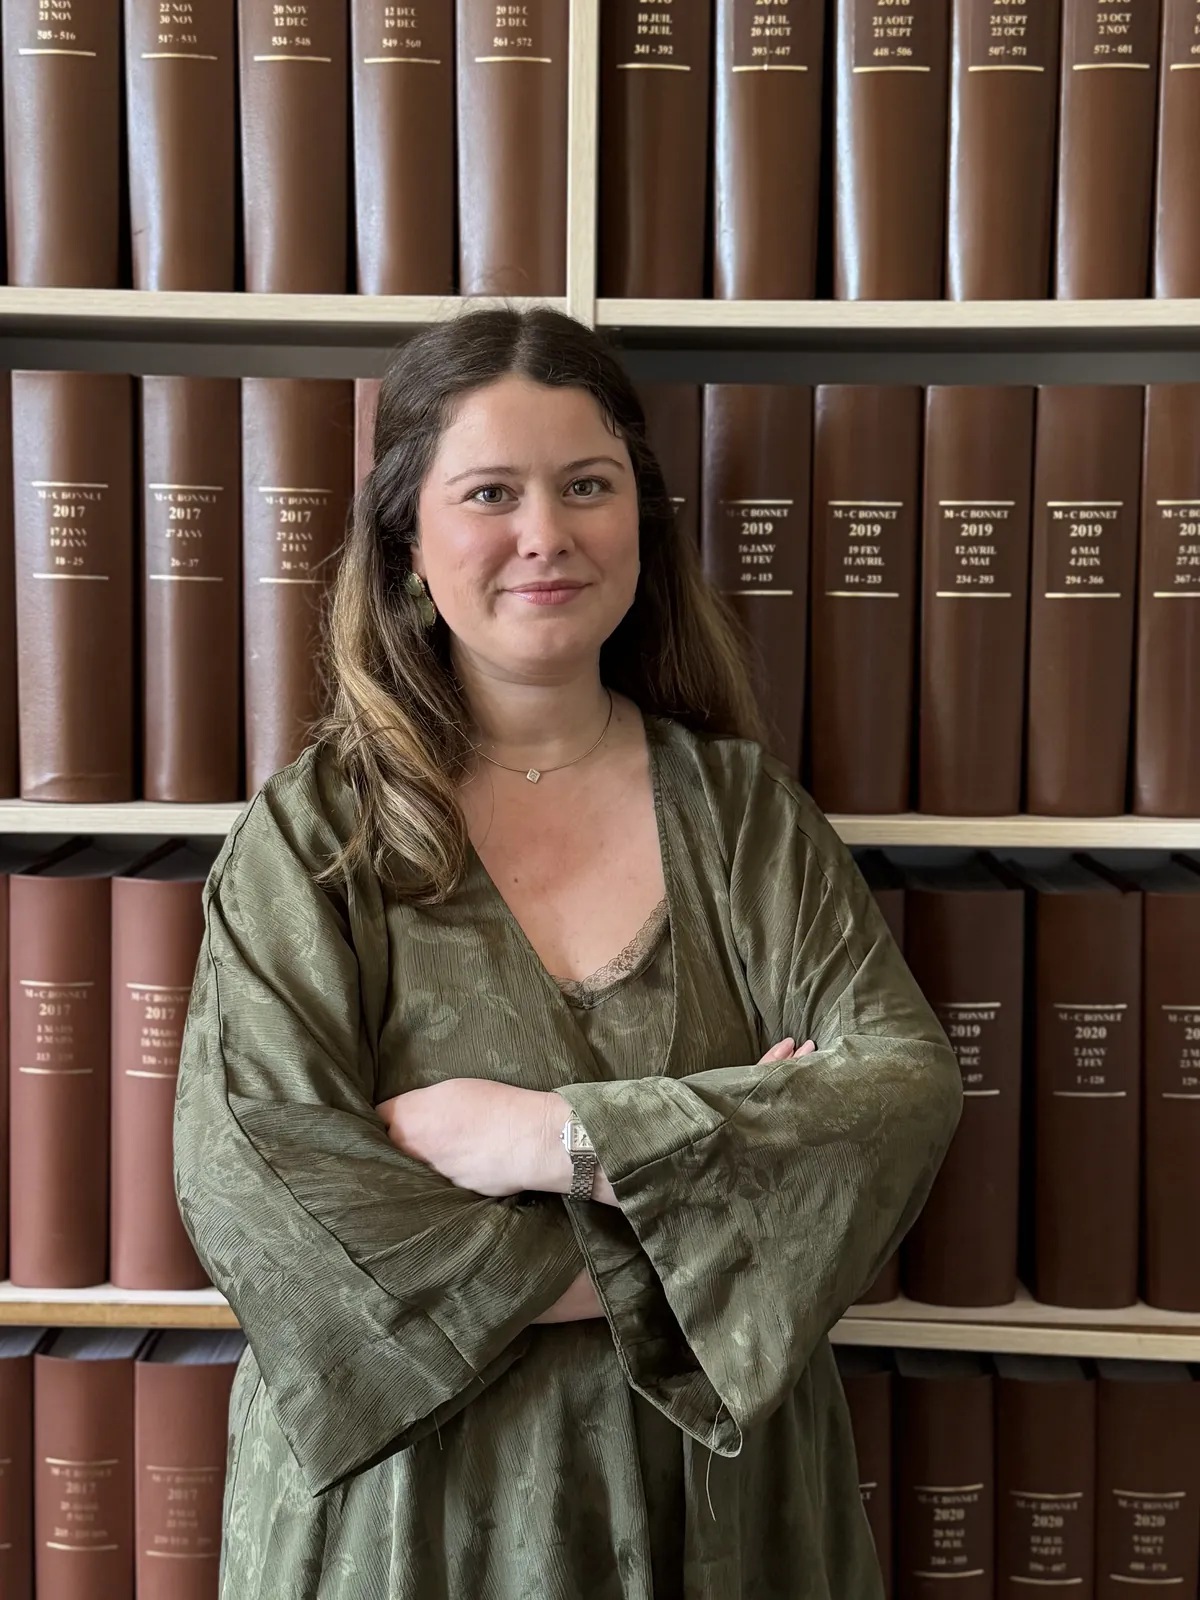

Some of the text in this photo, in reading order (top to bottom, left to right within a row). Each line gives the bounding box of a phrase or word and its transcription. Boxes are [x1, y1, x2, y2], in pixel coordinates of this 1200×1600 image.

[40, 0, 49, 9] 15
[160, 4, 170, 12] 22
[273, 5, 307, 14] 30 NOV
[385, 7, 417, 16] 12 DEC
[496, 6, 506, 15] 20
[39, 11, 48, 20] 21
[160, 15, 170, 24] 30
[638, 13, 672, 23] 10 JUIL
[754, 15, 789, 24] 20 JUIL
[990, 15, 1028, 24] 24 SEPT
[1096, 13, 1132, 22] 23 OCT
[275, 17, 308, 26] 12 DEC
[385, 19, 417, 28] 19 DEC
[496, 18, 506, 27] 23
[872, 16, 914, 25] 21 AOUT
[637, 25, 672, 35] 19 JUIL
[751, 27, 791, 36] 20 AOUT
[874, 28, 912, 37] 21 SEPT
[991, 27, 1026, 36] 22 OCT
[1098, 25, 1130, 34] 2 NOV
[60, 31, 76, 40] 516
[158, 34, 173, 43] 517
[382, 38, 397, 48] 549
[516, 38, 532, 46] 572
[634, 44, 673, 54] 341 392
[752, 46, 790, 56] 393 447
[873, 47, 912, 56] 448 506
[1012, 46, 1026, 56] 571
[1094, 44, 1132, 54] 572 601
[53, 504, 85, 518] 2017
[169, 507, 201, 520] 2017
[750, 509, 789, 517] BONNET
[858, 510, 897, 519] BONNET
[970, 510, 1008, 518] BONNET
[1080, 510, 1117, 519] BONNET
[1189, 509, 1200, 518] BO
[280, 510, 311, 523] 2017
[742, 522, 773, 535] 2019
[849, 523, 881, 536] 2019
[960, 523, 993, 536] 2019
[1070, 524, 1102, 537] 2019
[1179, 523, 1200, 536] 201
[276, 532, 286, 540] 27
[738, 544, 776, 553] 16 JANV
[849, 546, 880, 554] 19 FEV
[955, 546, 996, 554] 12 AVRIL
[1071, 546, 1100, 555] 6 MAI
[1187, 545, 1200, 554] JU
[742, 555, 772, 564] 18 FEV
[844, 557, 885, 566] 11 AVRIL
[961, 557, 990, 566] 6 MAI
[1069, 557, 1100, 566] 4 JUIN
[1176, 556, 1200, 566] 27 JU
[758, 573, 773, 582] 113
[845, 575, 882, 584] 114 233
[956, 575, 994, 584] 234 293
[1065, 575, 1104, 584] 294 366
[1174, 574, 1191, 584] 367
[39, 1003, 71, 1016] 2017
[145, 1006, 175, 1020] 2017
[958, 1011, 996, 1020] BONNET
[950, 1025, 981, 1037] 2019
[1075, 1026, 1107, 1038] 2020
[1185, 1027, 1200, 1040] 20
[934, 1508, 965, 1521] 2020
[1032, 1514, 1064, 1527] 2020
[1134, 1514, 1166, 1527] 2020
